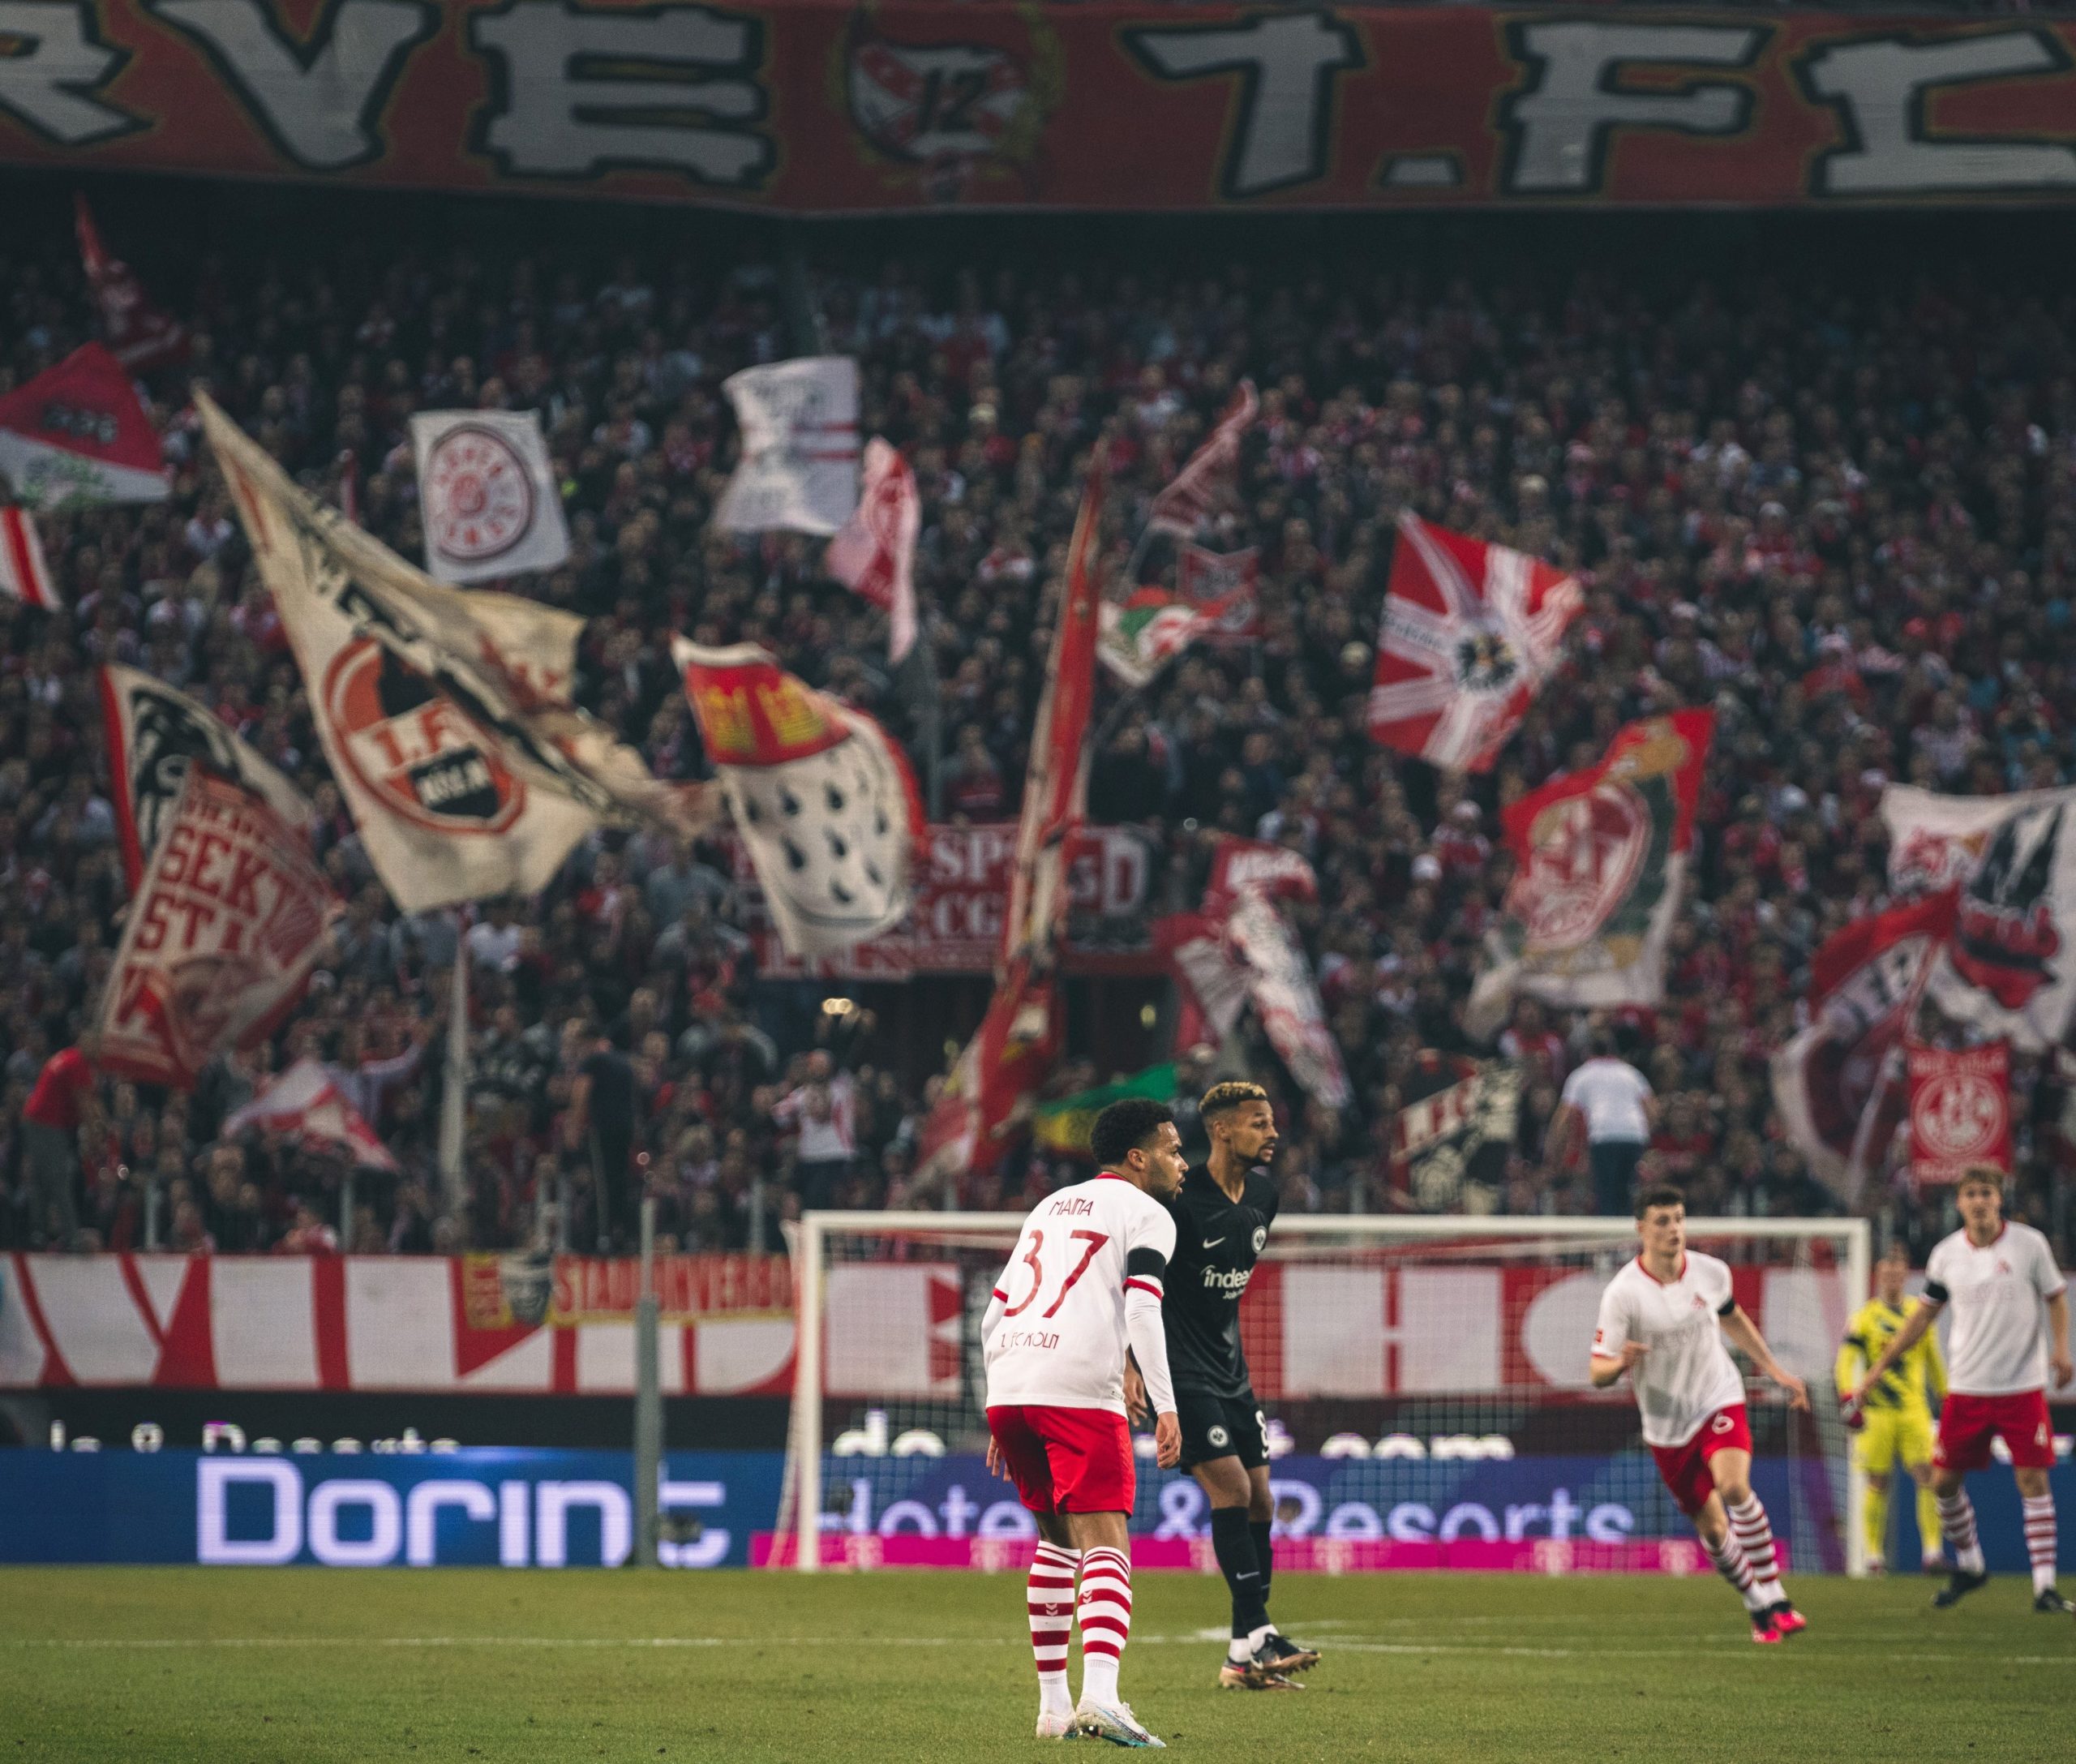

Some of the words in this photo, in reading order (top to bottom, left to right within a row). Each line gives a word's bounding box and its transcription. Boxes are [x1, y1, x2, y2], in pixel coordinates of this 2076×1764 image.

[1048, 1198, 1094, 1217] MAINA
[1004, 1229, 1110, 1318] 37
[1202, 1266, 1255, 1289] indee
